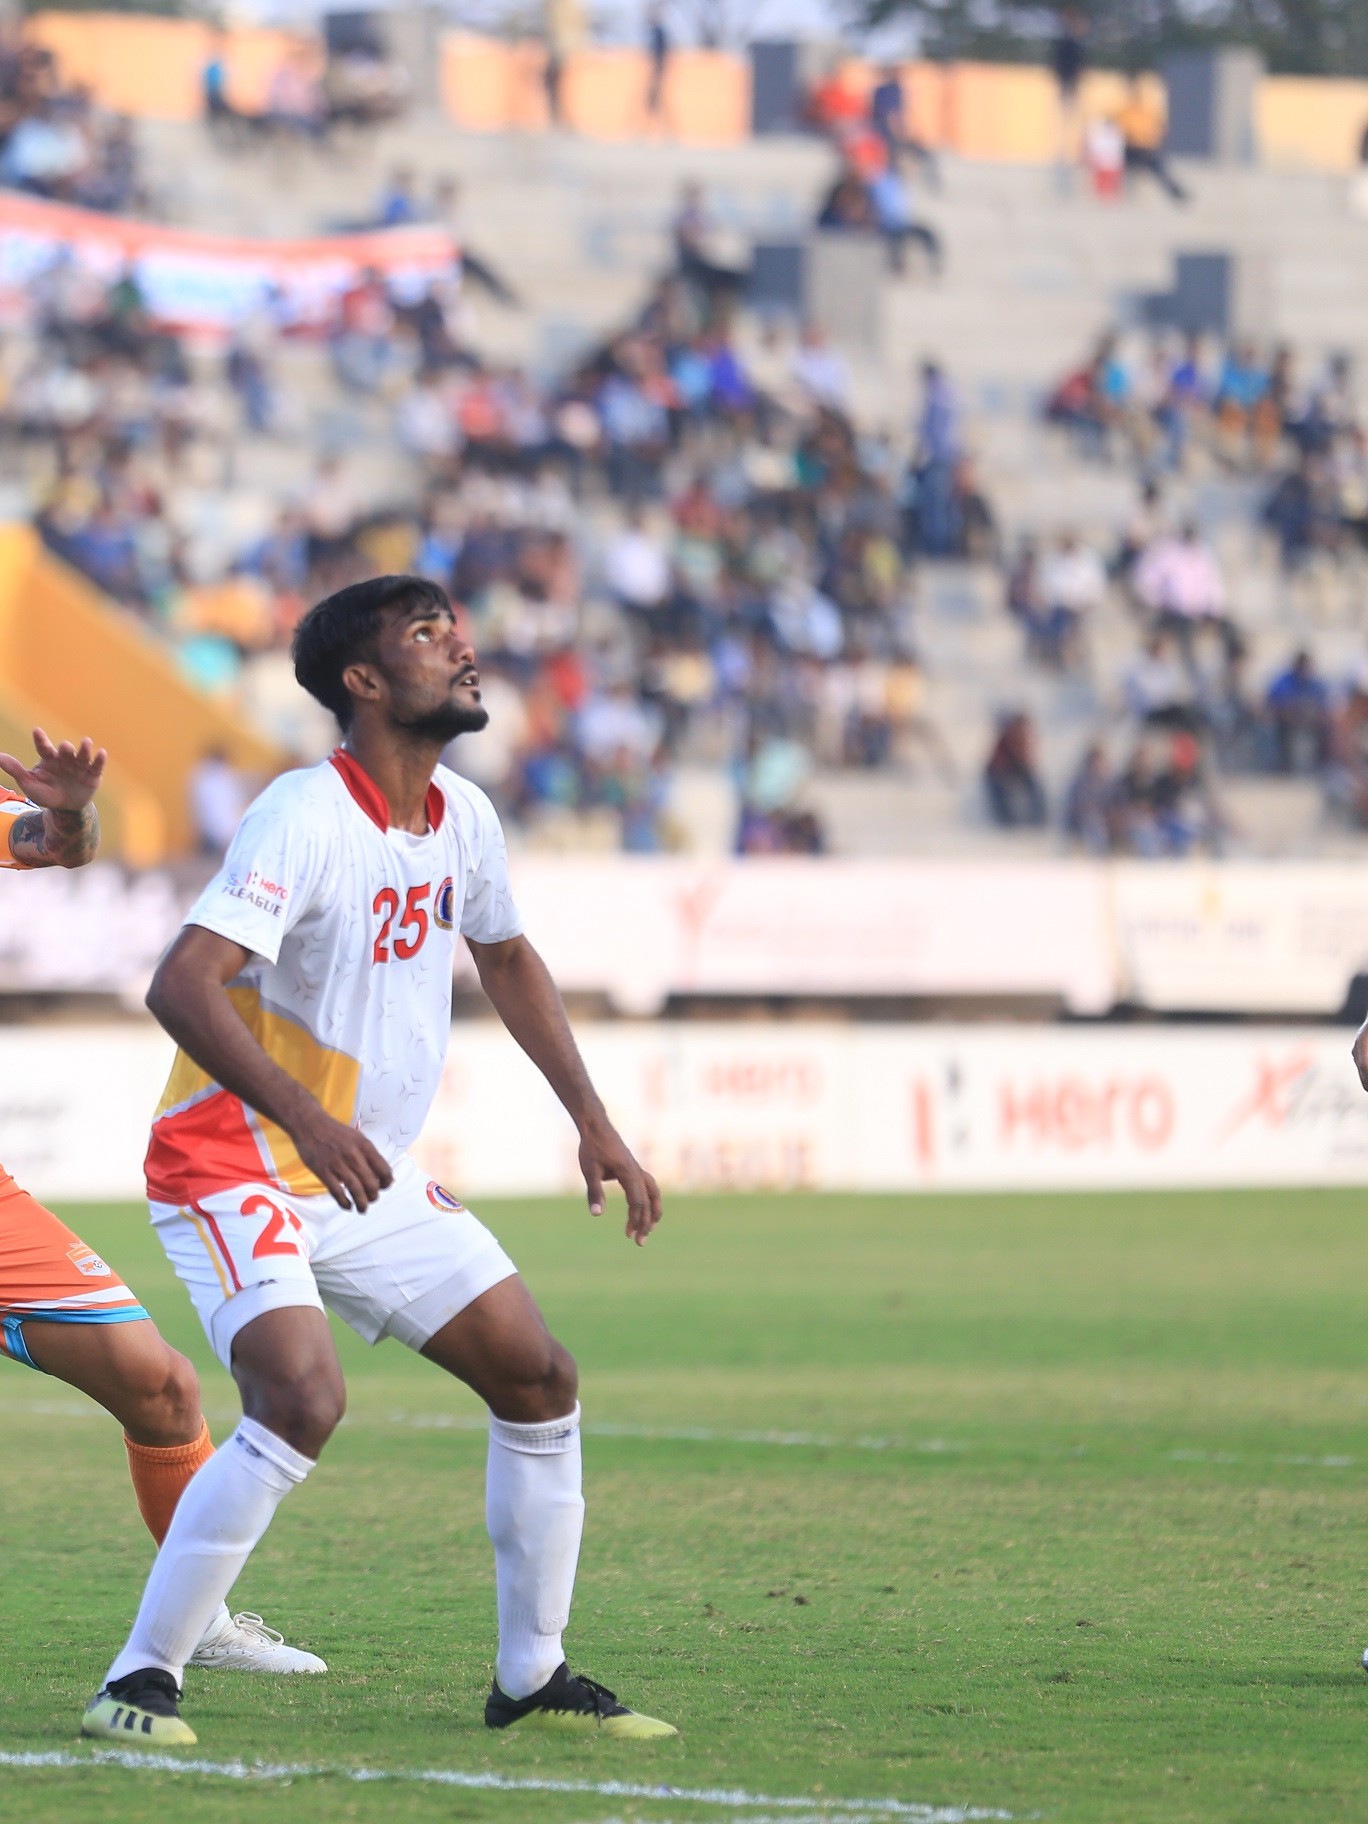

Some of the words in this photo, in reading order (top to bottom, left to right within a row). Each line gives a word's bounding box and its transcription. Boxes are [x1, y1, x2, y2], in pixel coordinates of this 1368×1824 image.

[372, 881, 431, 966] 25
[998, 1070, 1175, 1154] Hero
[240, 1194, 303, 1260] 2
